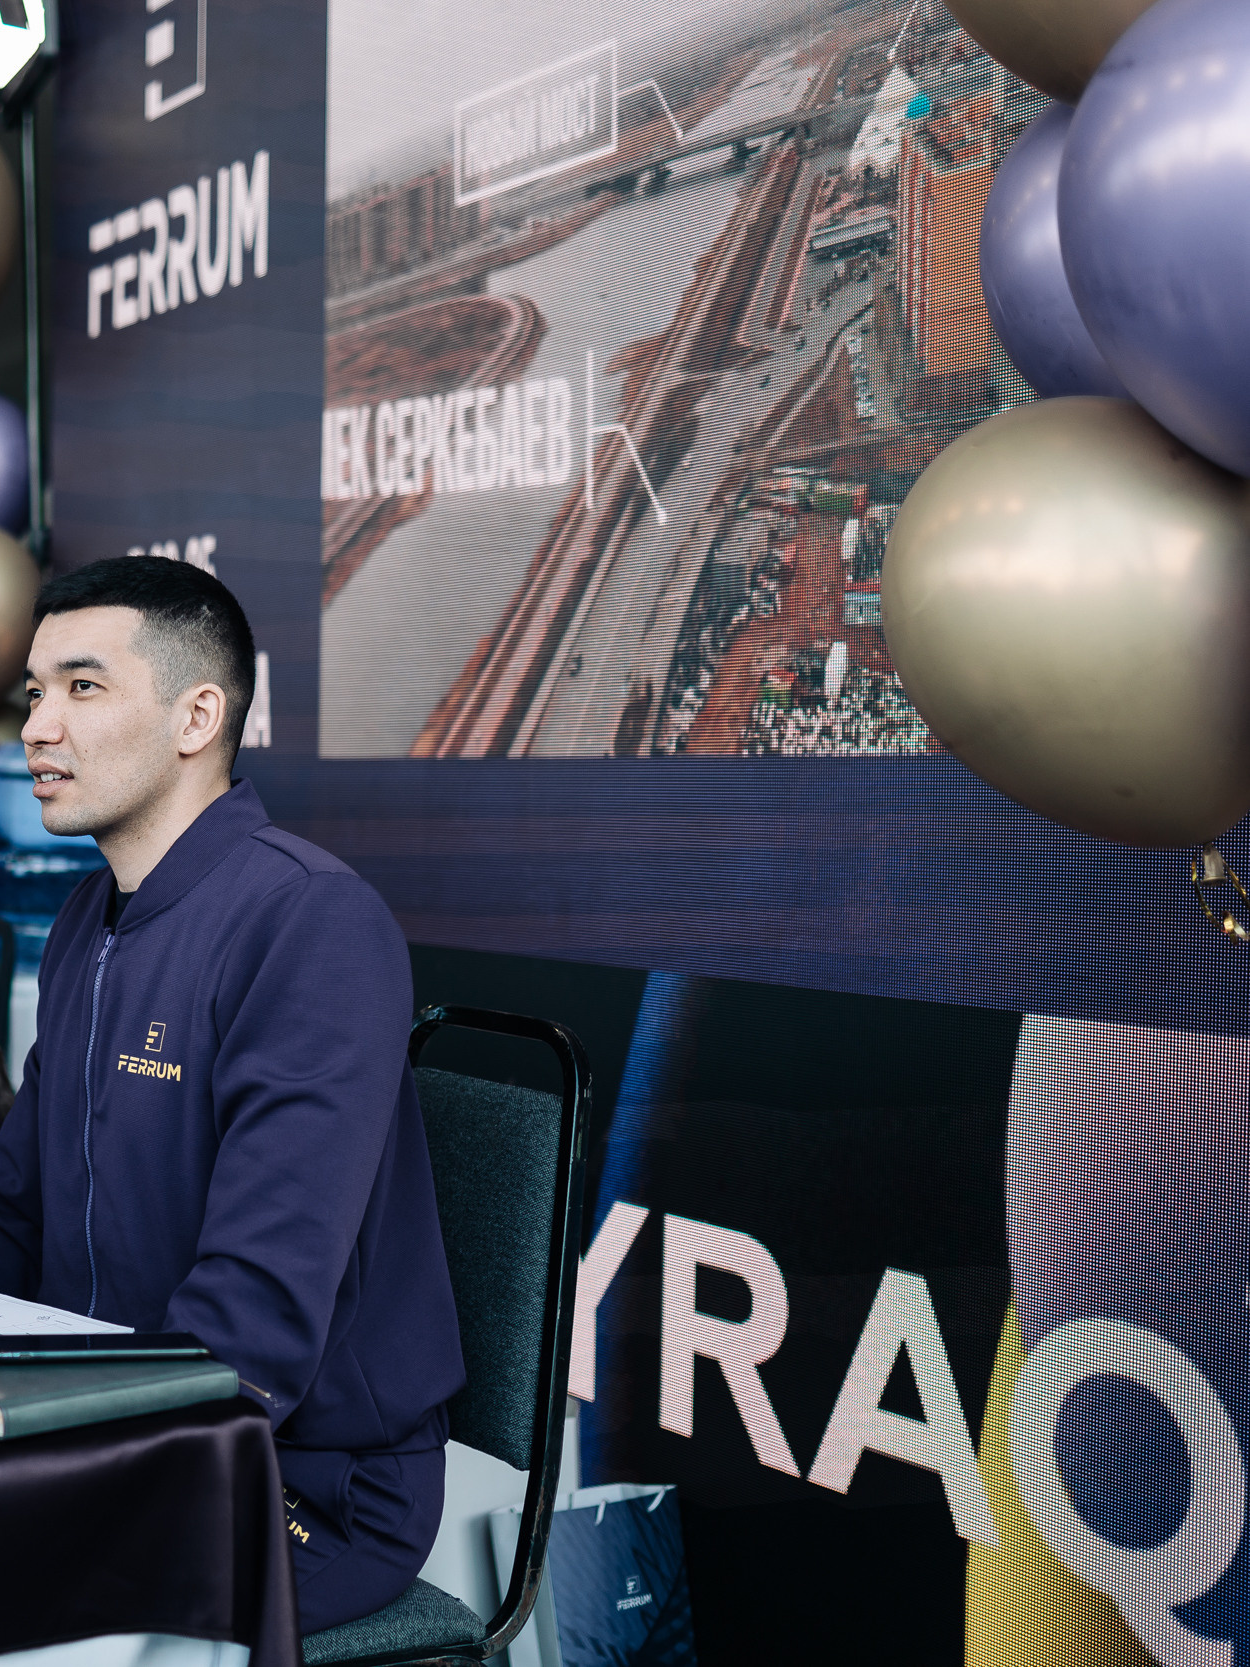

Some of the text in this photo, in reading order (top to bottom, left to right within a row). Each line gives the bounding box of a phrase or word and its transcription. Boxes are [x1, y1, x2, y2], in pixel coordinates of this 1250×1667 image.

[539, 73, 601, 152] МОСТ
[87, 149, 270, 340] FERRUM
[375, 376, 572, 499] СЕРКЕБАЕВ
[117, 1053, 182, 1082] FERRUM
